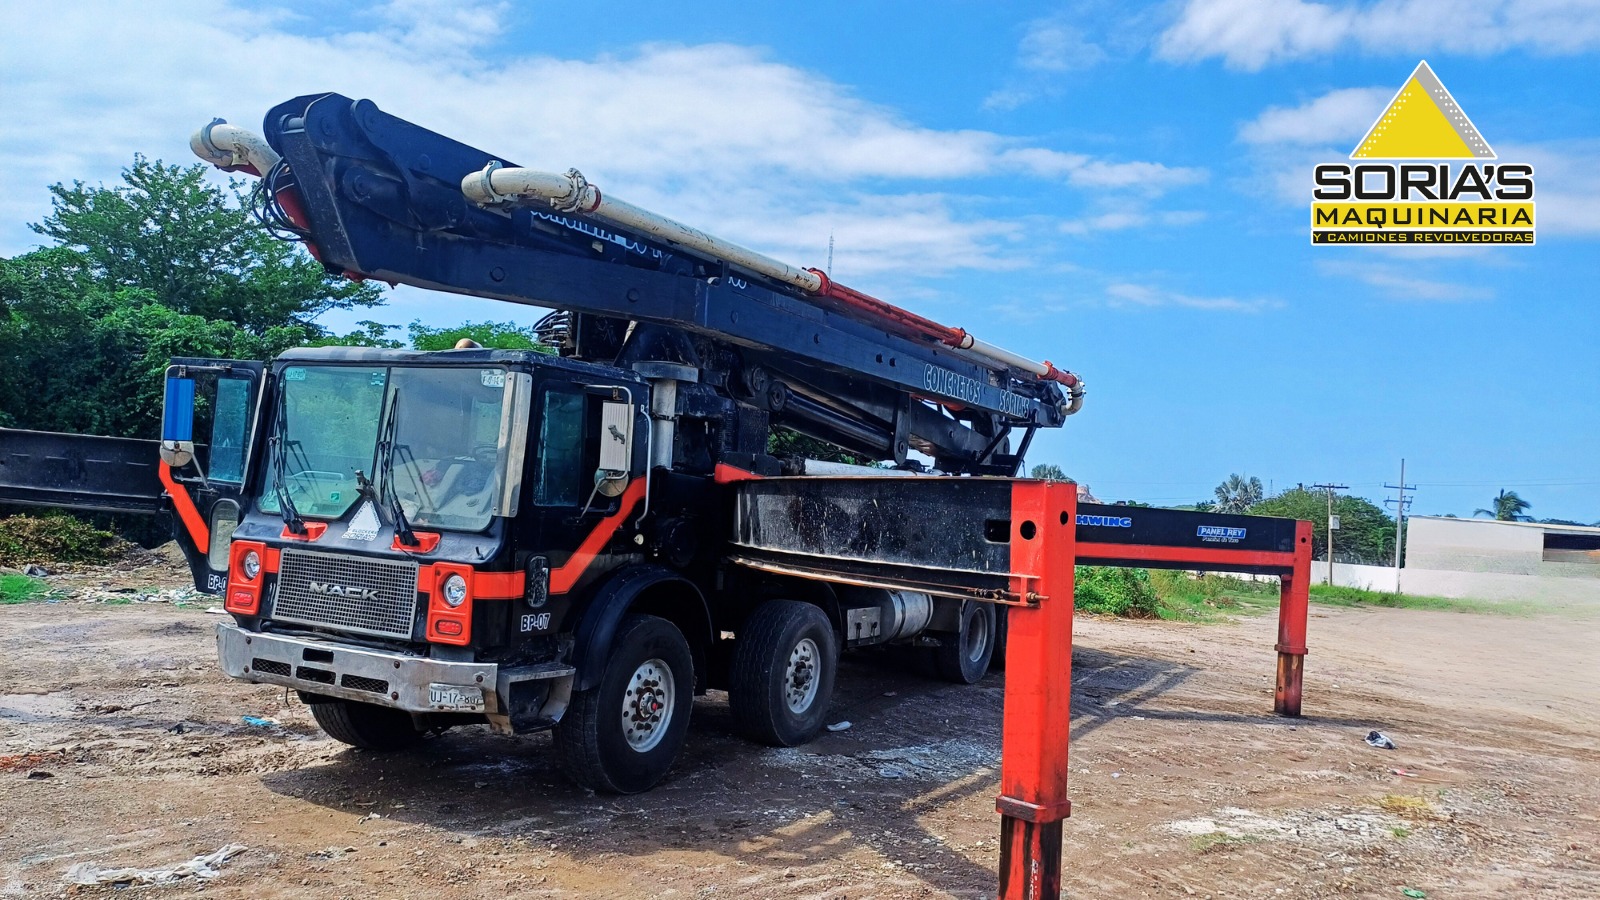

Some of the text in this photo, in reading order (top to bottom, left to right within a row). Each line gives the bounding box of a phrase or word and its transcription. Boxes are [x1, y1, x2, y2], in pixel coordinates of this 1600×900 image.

[923, 363, 981, 405] CONCRETOS
[1076, 514, 1132, 528] HWING
[1201, 527, 1243, 537] PANEL REY
[208, 574, 227, 591] BP-0
[309, 582, 379, 601] MACK
[521, 612, 551, 632] BP-07
